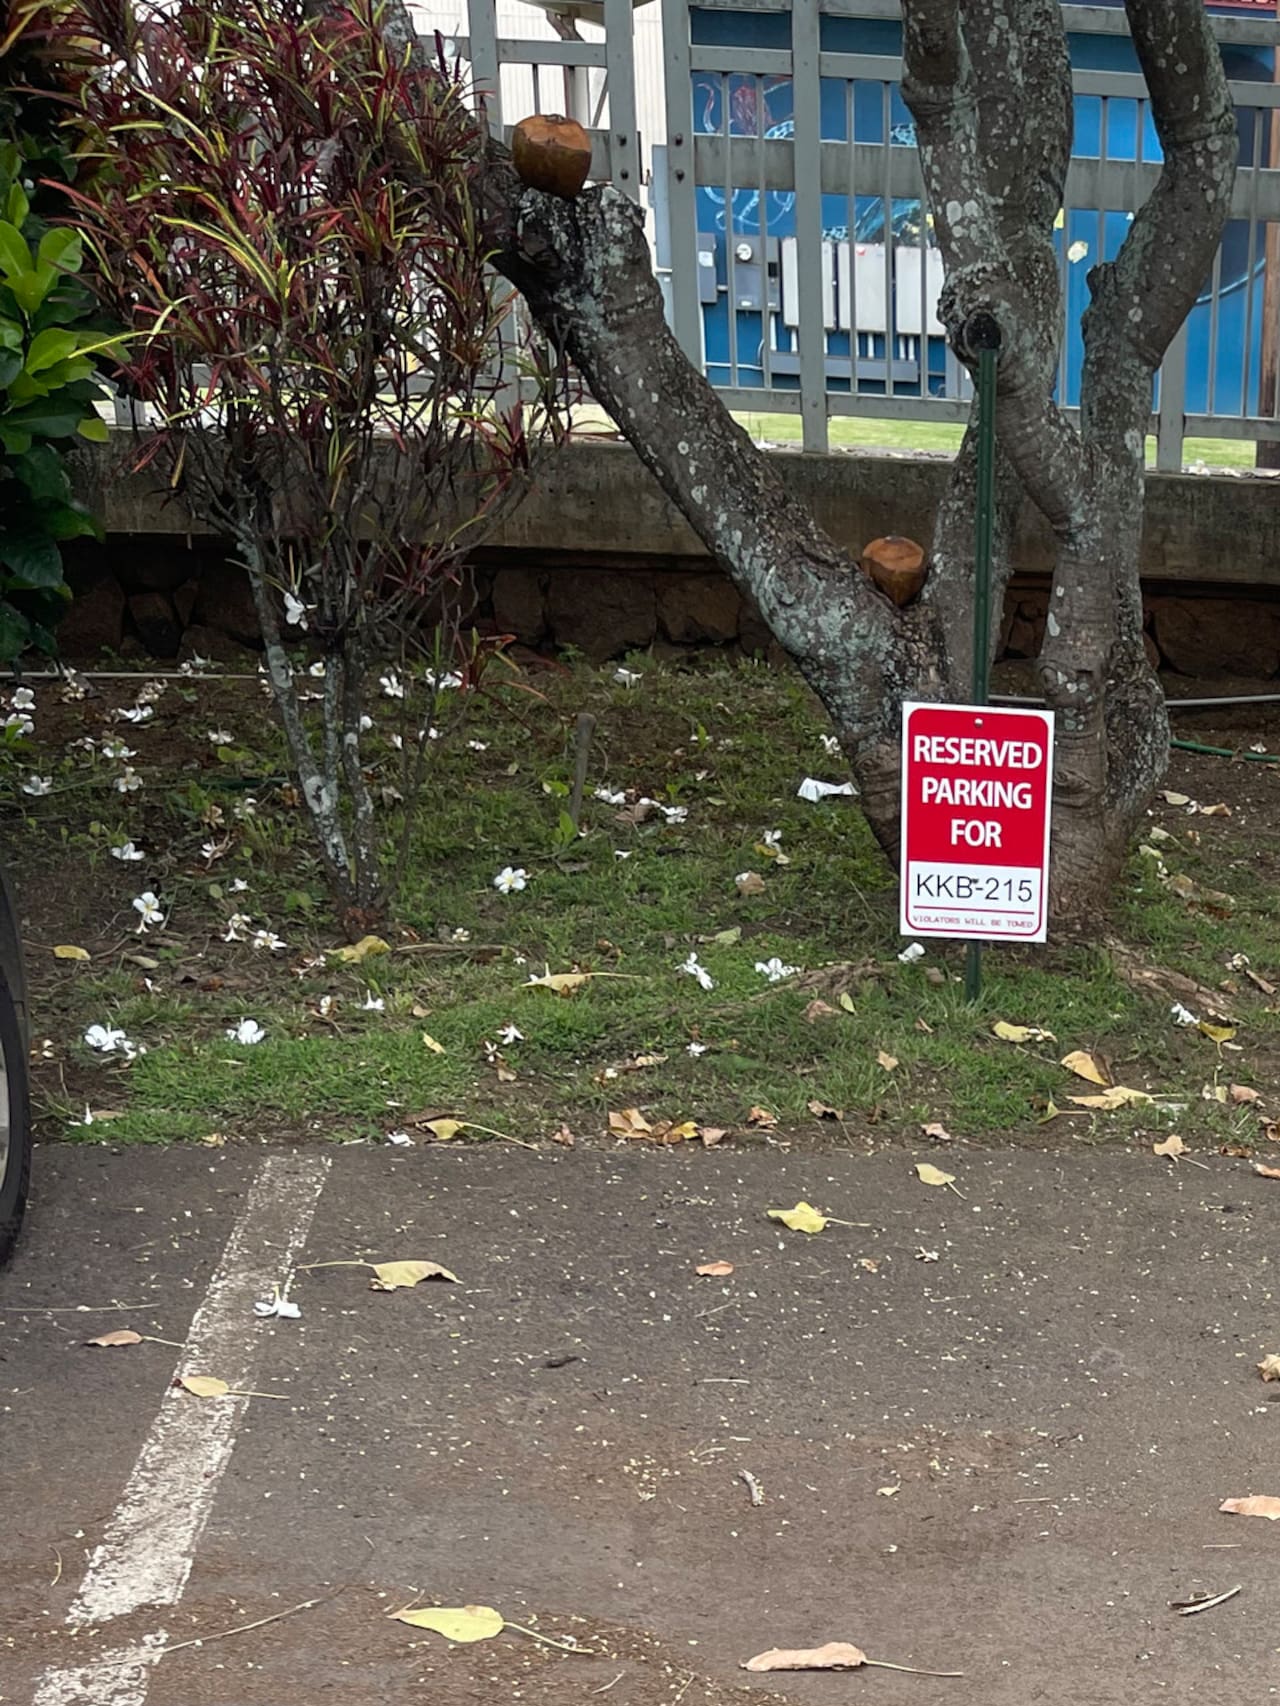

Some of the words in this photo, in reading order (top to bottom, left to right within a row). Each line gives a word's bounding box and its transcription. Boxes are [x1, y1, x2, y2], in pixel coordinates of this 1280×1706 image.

[914, 735, 1043, 769] RESERVED
[921, 776, 1032, 809] PARKING
[951, 819, 1002, 848] FOR
[916, 873, 1032, 902] KKB-215
[913, 915, 960, 925] VIOLATORS
[964, 918, 985, 926] WILL
[991, 919, 1001, 927] BE
[1007, 920, 1033, 928] TOWED
